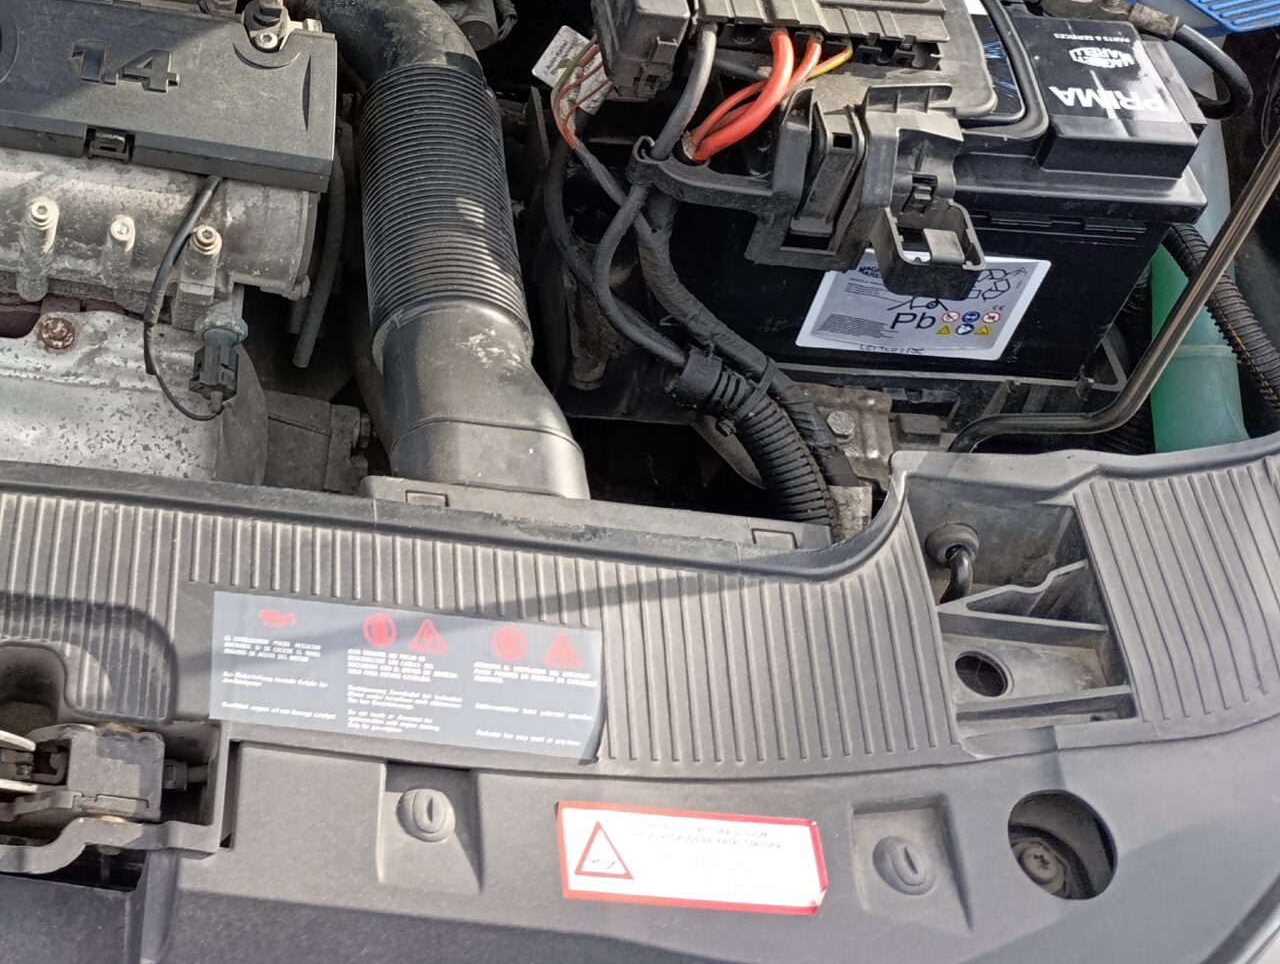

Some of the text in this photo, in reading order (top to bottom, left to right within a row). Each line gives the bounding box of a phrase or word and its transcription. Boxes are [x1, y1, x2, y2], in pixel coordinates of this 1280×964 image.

[69, 38, 180, 93] 1.4
[1048, 86, 1169, 112] PRIMA
[890, 312, 937, 329] Pb
